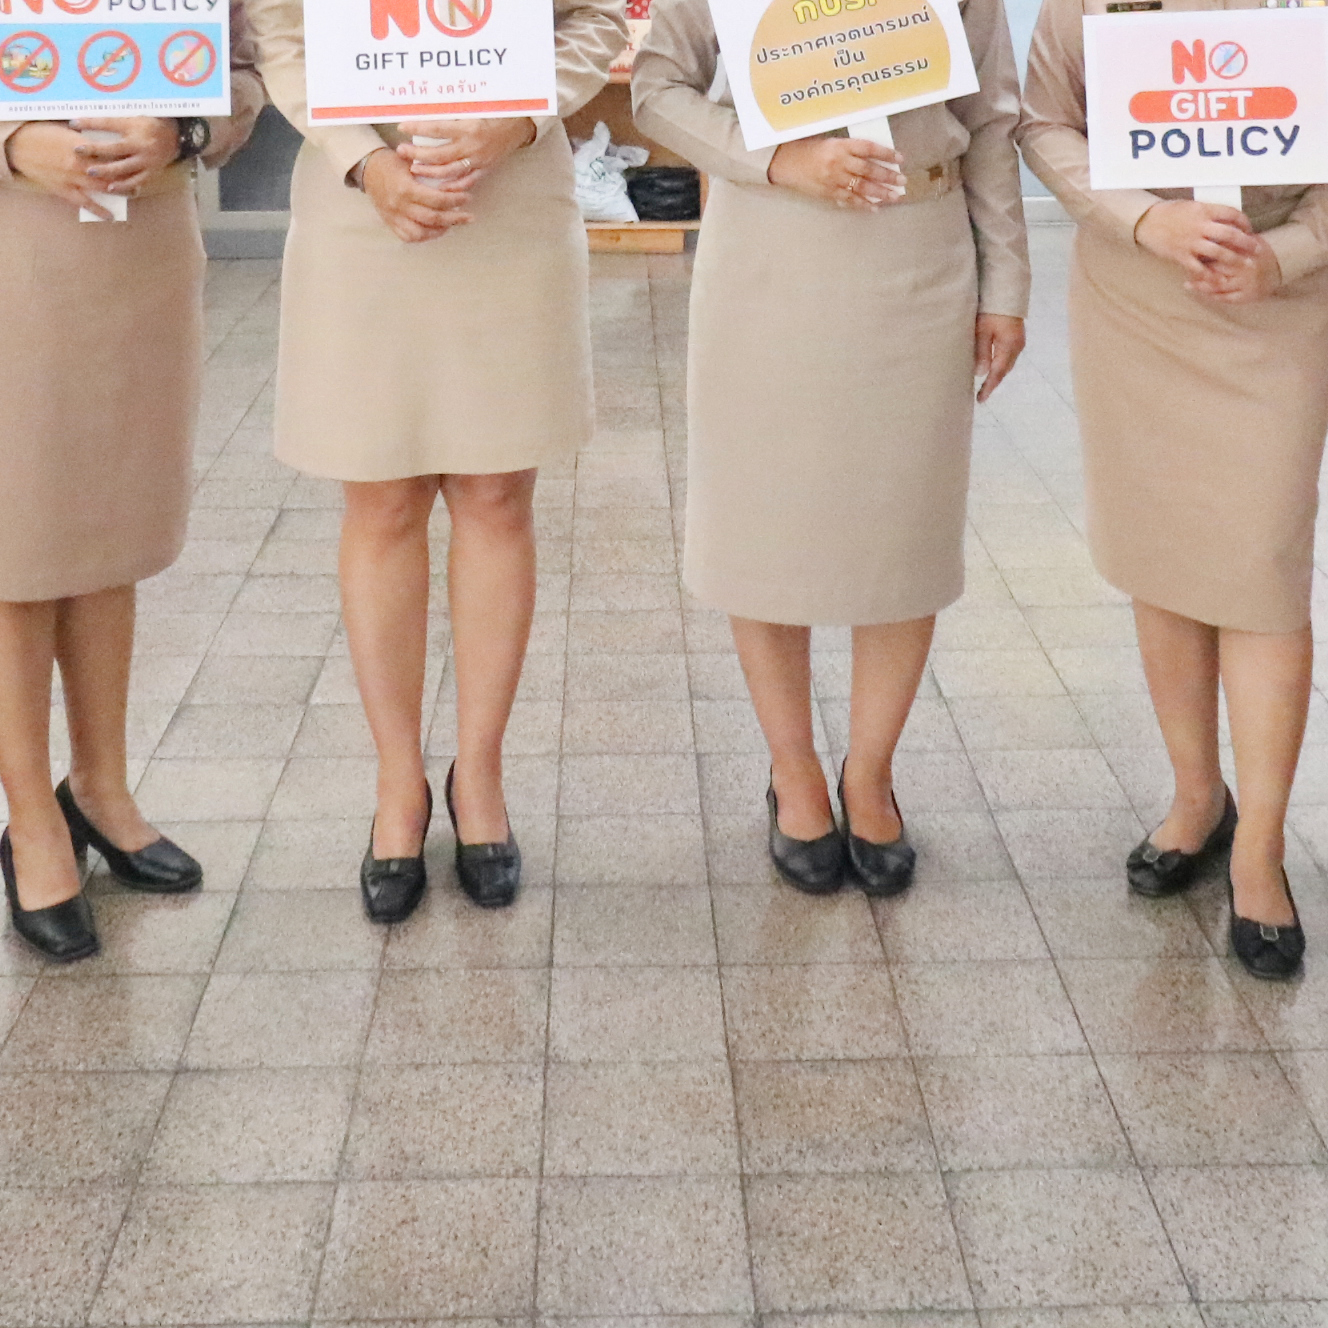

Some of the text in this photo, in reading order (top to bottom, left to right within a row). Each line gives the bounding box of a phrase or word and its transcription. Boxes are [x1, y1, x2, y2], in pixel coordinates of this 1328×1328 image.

[756, 5, 931, 64] ประกาศเจตนารมณ์
[355, 47, 508, 71] GIFT POLICY
[833, 48, 866, 68] เป็น
[779, 56, 930, 106] องค์กรคุณธรรม
[1169, 90, 1253, 120] GIFT
[1128, 124, 1300, 160] POLICY
